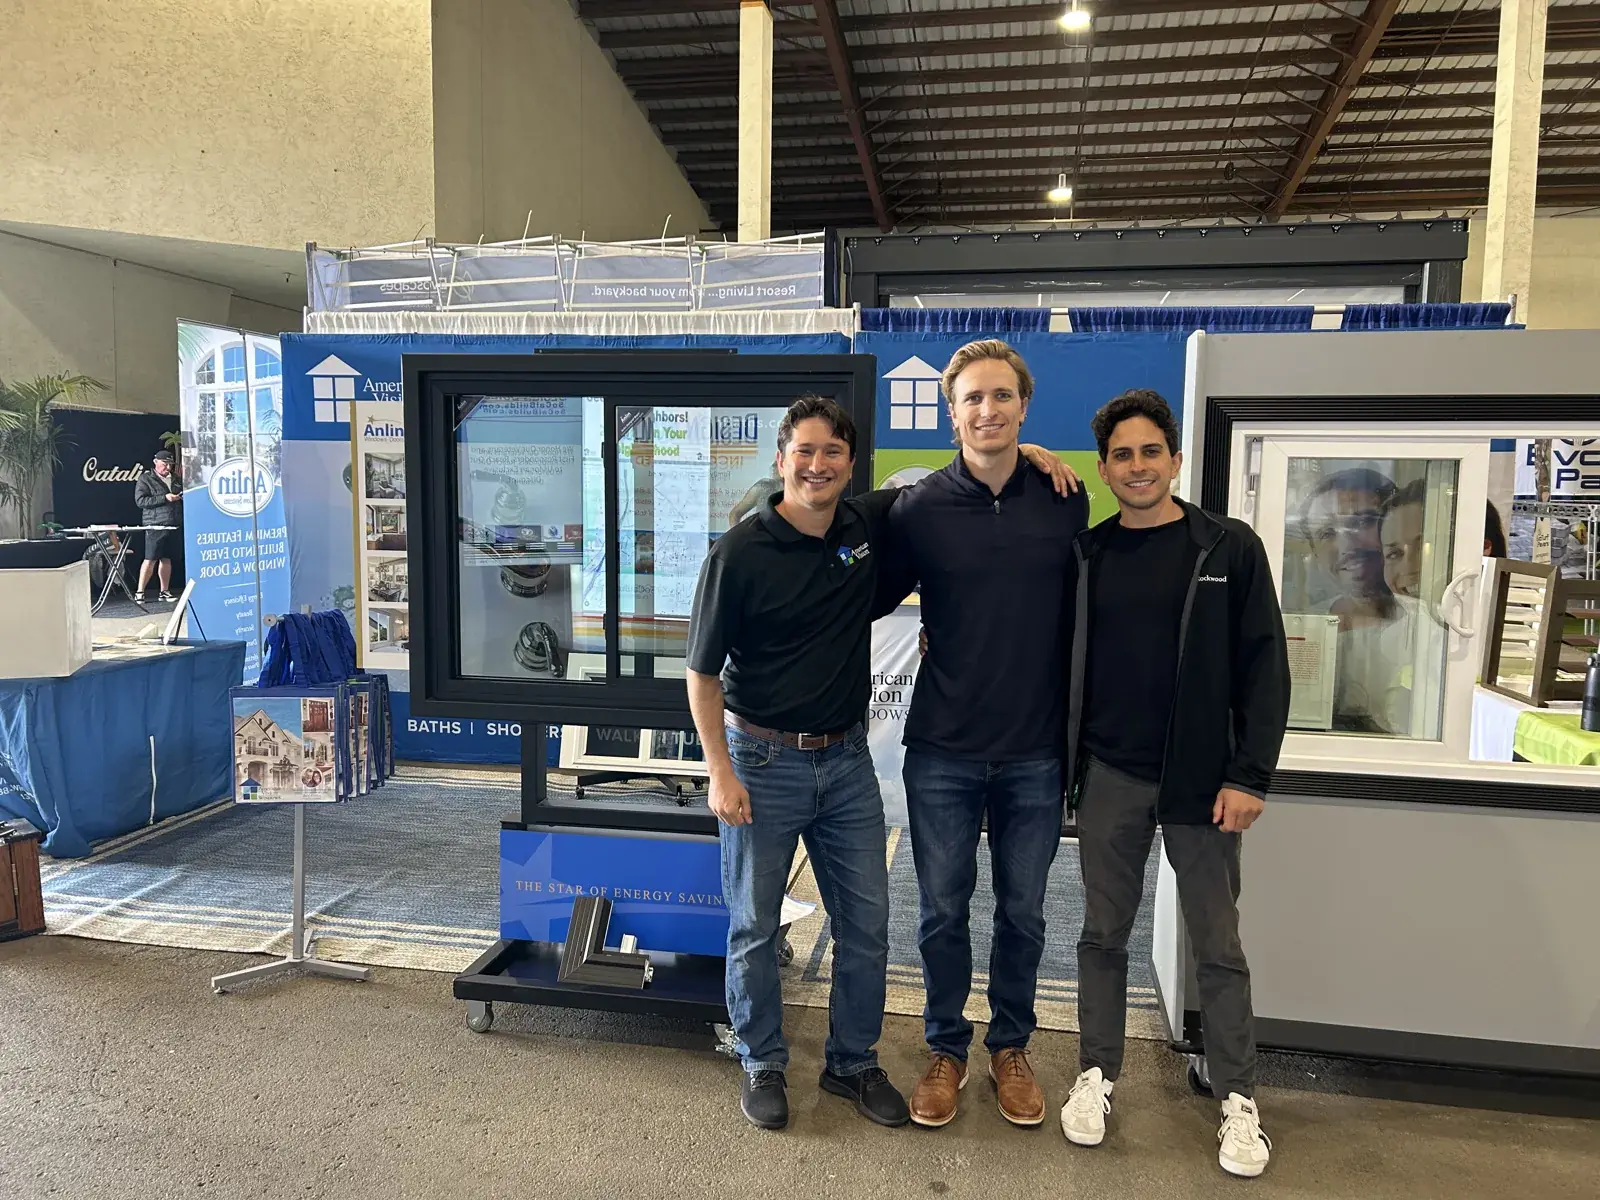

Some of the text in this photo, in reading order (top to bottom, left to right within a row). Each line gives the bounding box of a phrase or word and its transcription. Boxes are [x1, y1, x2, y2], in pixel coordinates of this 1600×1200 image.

[364, 423, 404, 437] Anlin
[663, 426, 687, 439] Your
[83, 457, 150, 482] Catali
[872, 687, 903, 703] ion
[407, 719, 461, 734] BATHS
[515, 880, 723, 906] THE STAR OF ENERGY SAVIN
